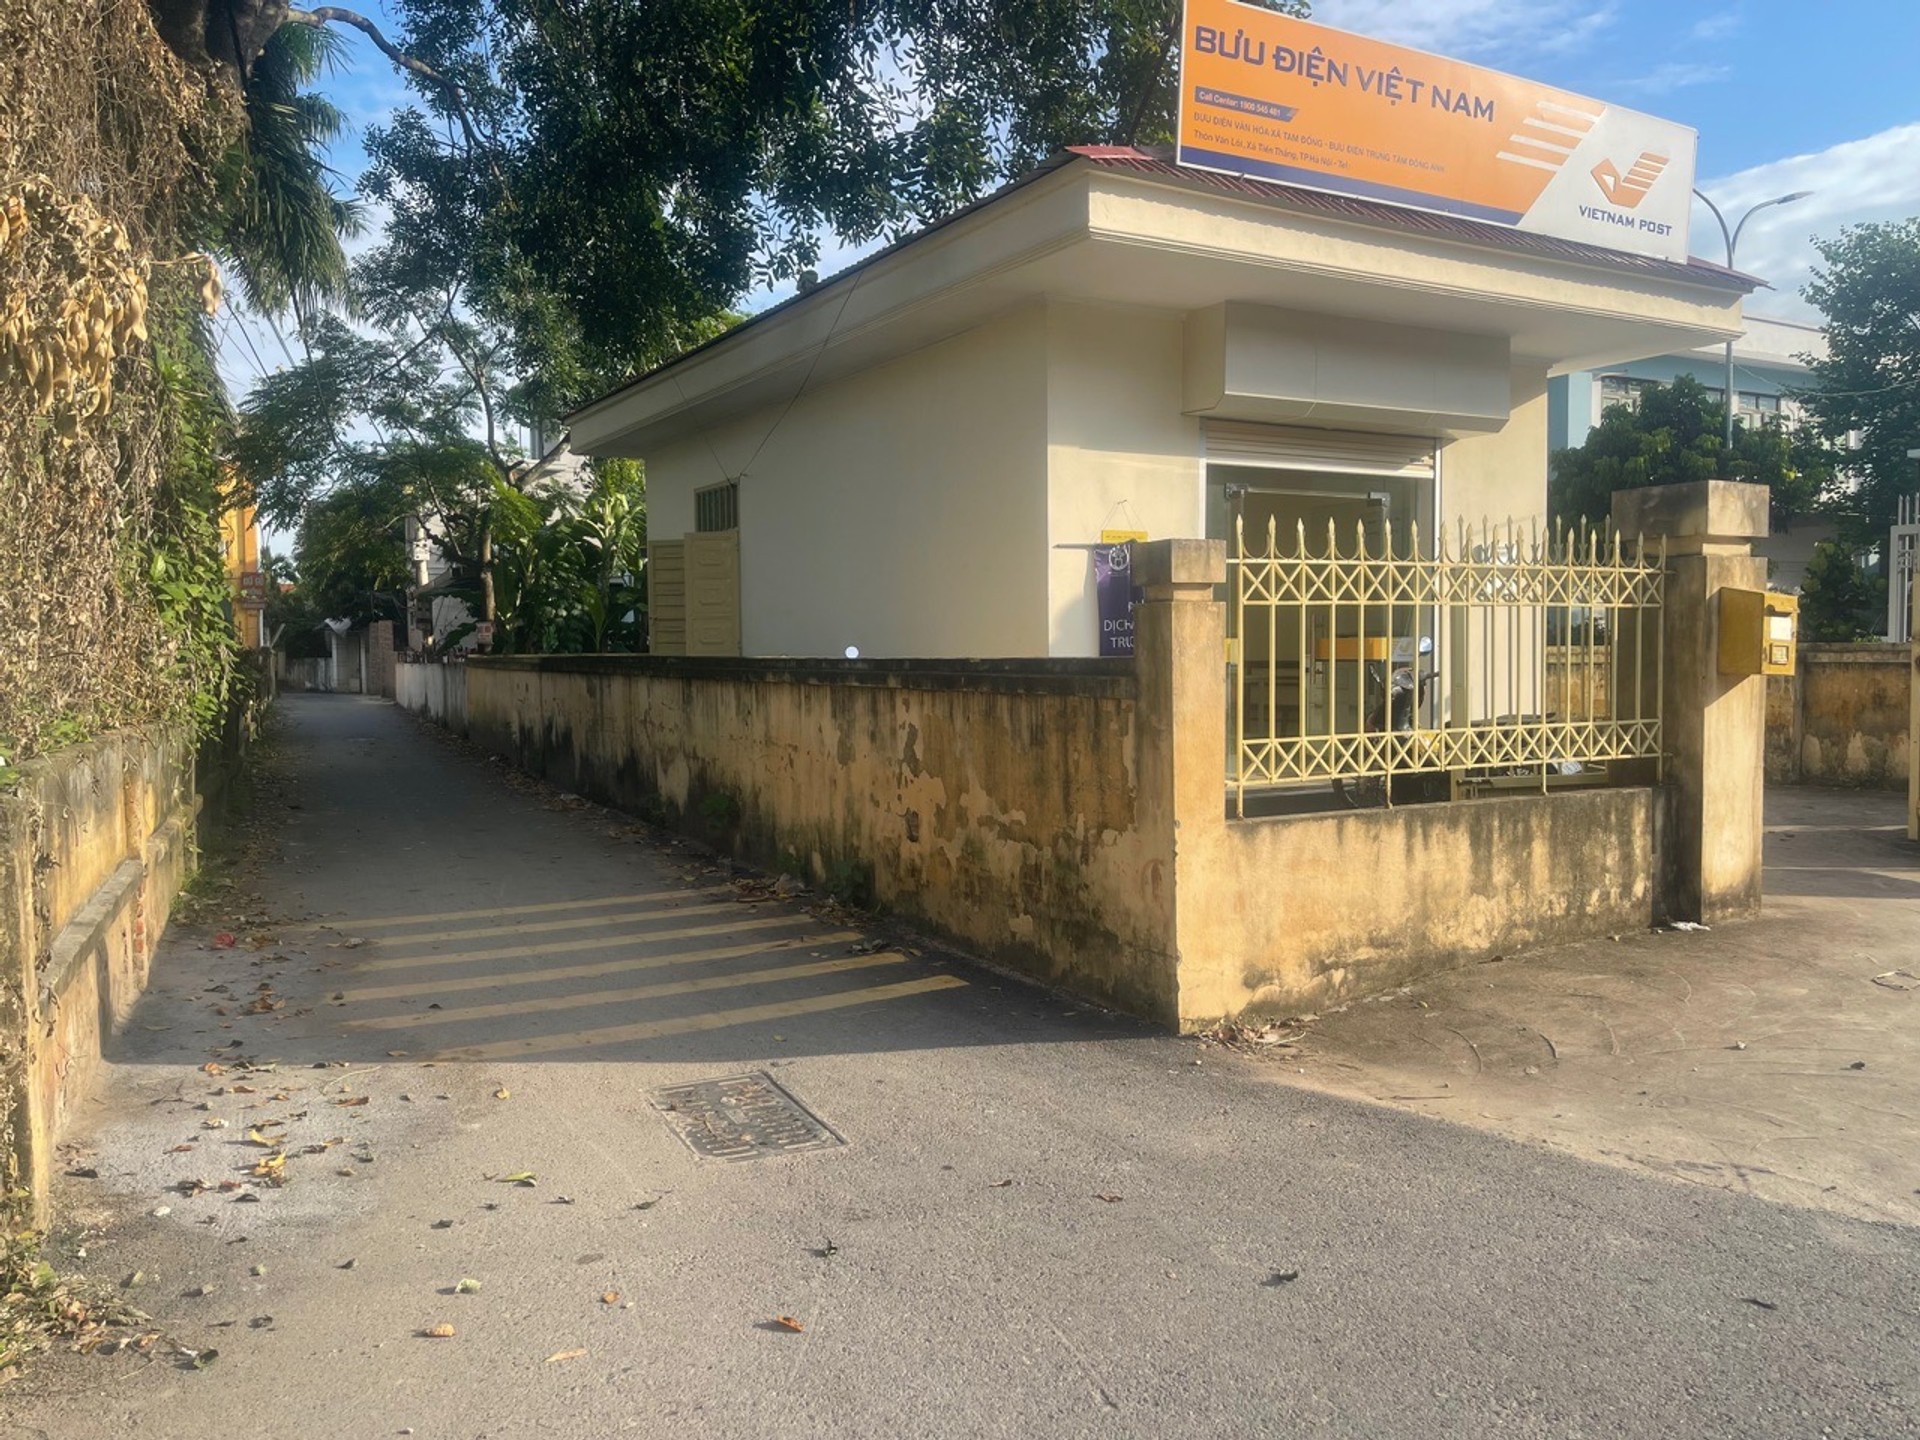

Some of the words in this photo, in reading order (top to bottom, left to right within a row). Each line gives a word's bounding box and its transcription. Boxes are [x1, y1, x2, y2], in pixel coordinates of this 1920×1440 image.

[1195, 25, 1265, 66] BƯU
[1272, 45, 1349, 87] ĐIỆN
[1355, 66, 1425, 106] VIỆT
[1431, 85, 1494, 122] NAM
[1199, 91, 1213, 102] Call
[1579, 205, 1635, 228] VIETNAM
[1639, 219, 1673, 236] POST
